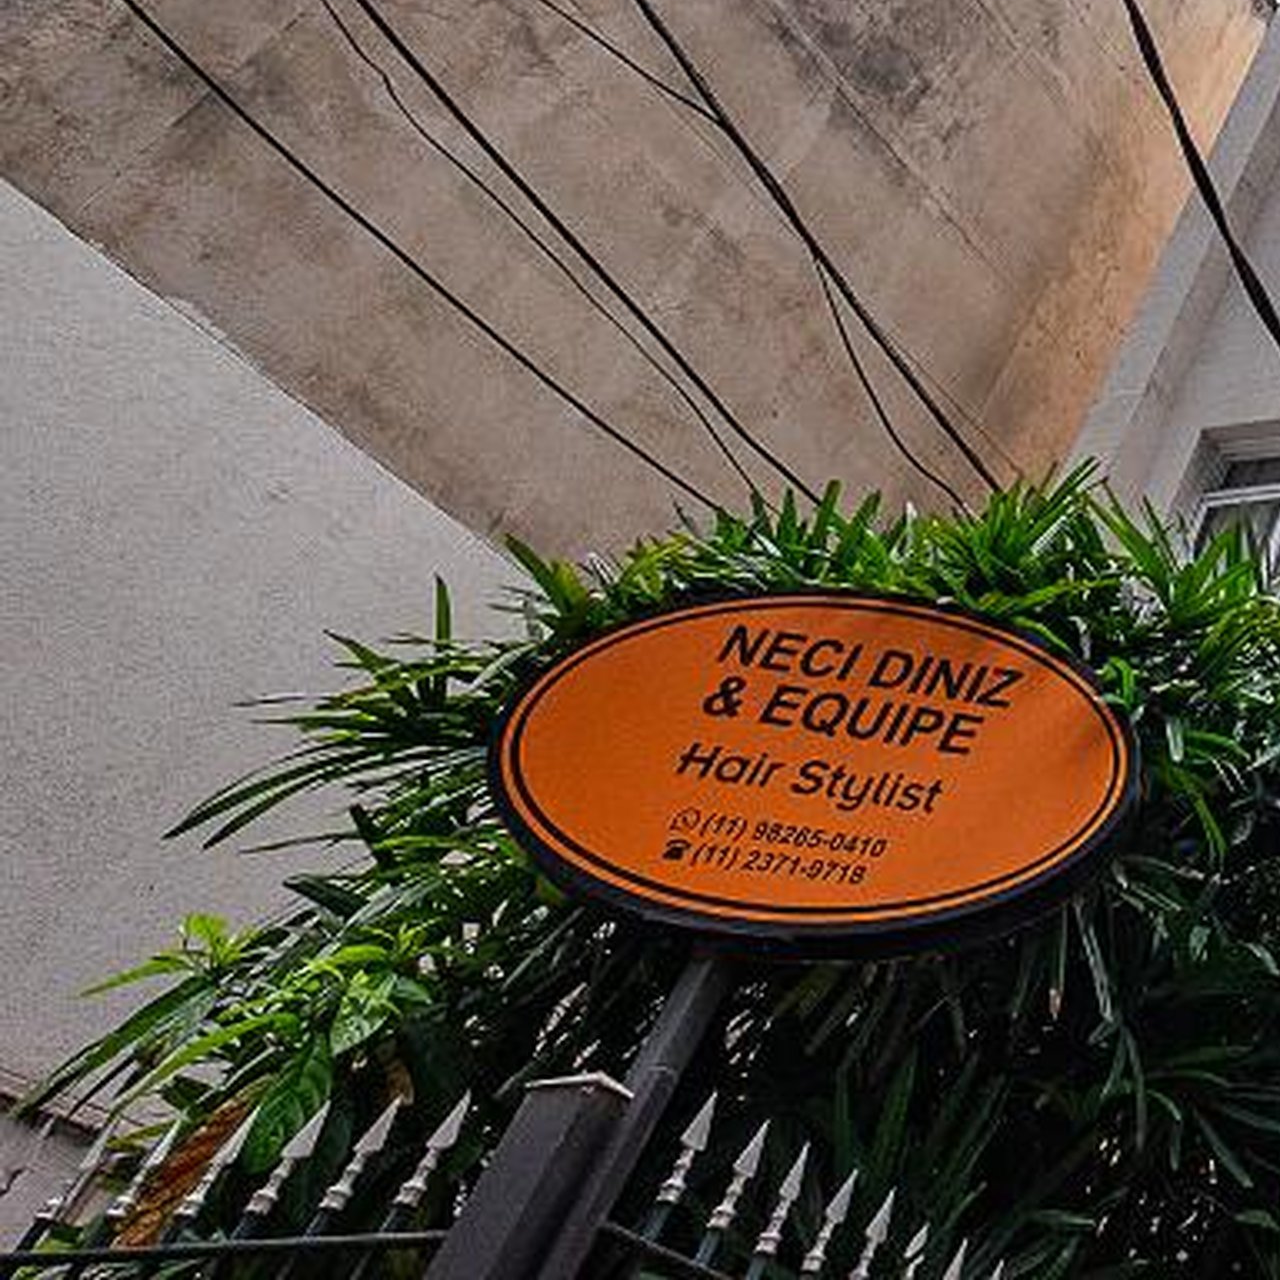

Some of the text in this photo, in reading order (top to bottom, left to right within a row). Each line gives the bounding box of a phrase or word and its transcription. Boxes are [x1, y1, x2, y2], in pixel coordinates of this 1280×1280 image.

[718, 624, 1026, 709] NECI DINIZ
[702, 676, 985, 756] & EQUIPE
[677, 742, 943, 814] Hair Stylist
[690, 843, 868, 885] (11) 2371-9718
[699, 812, 888, 858] (11) 98265-0410
